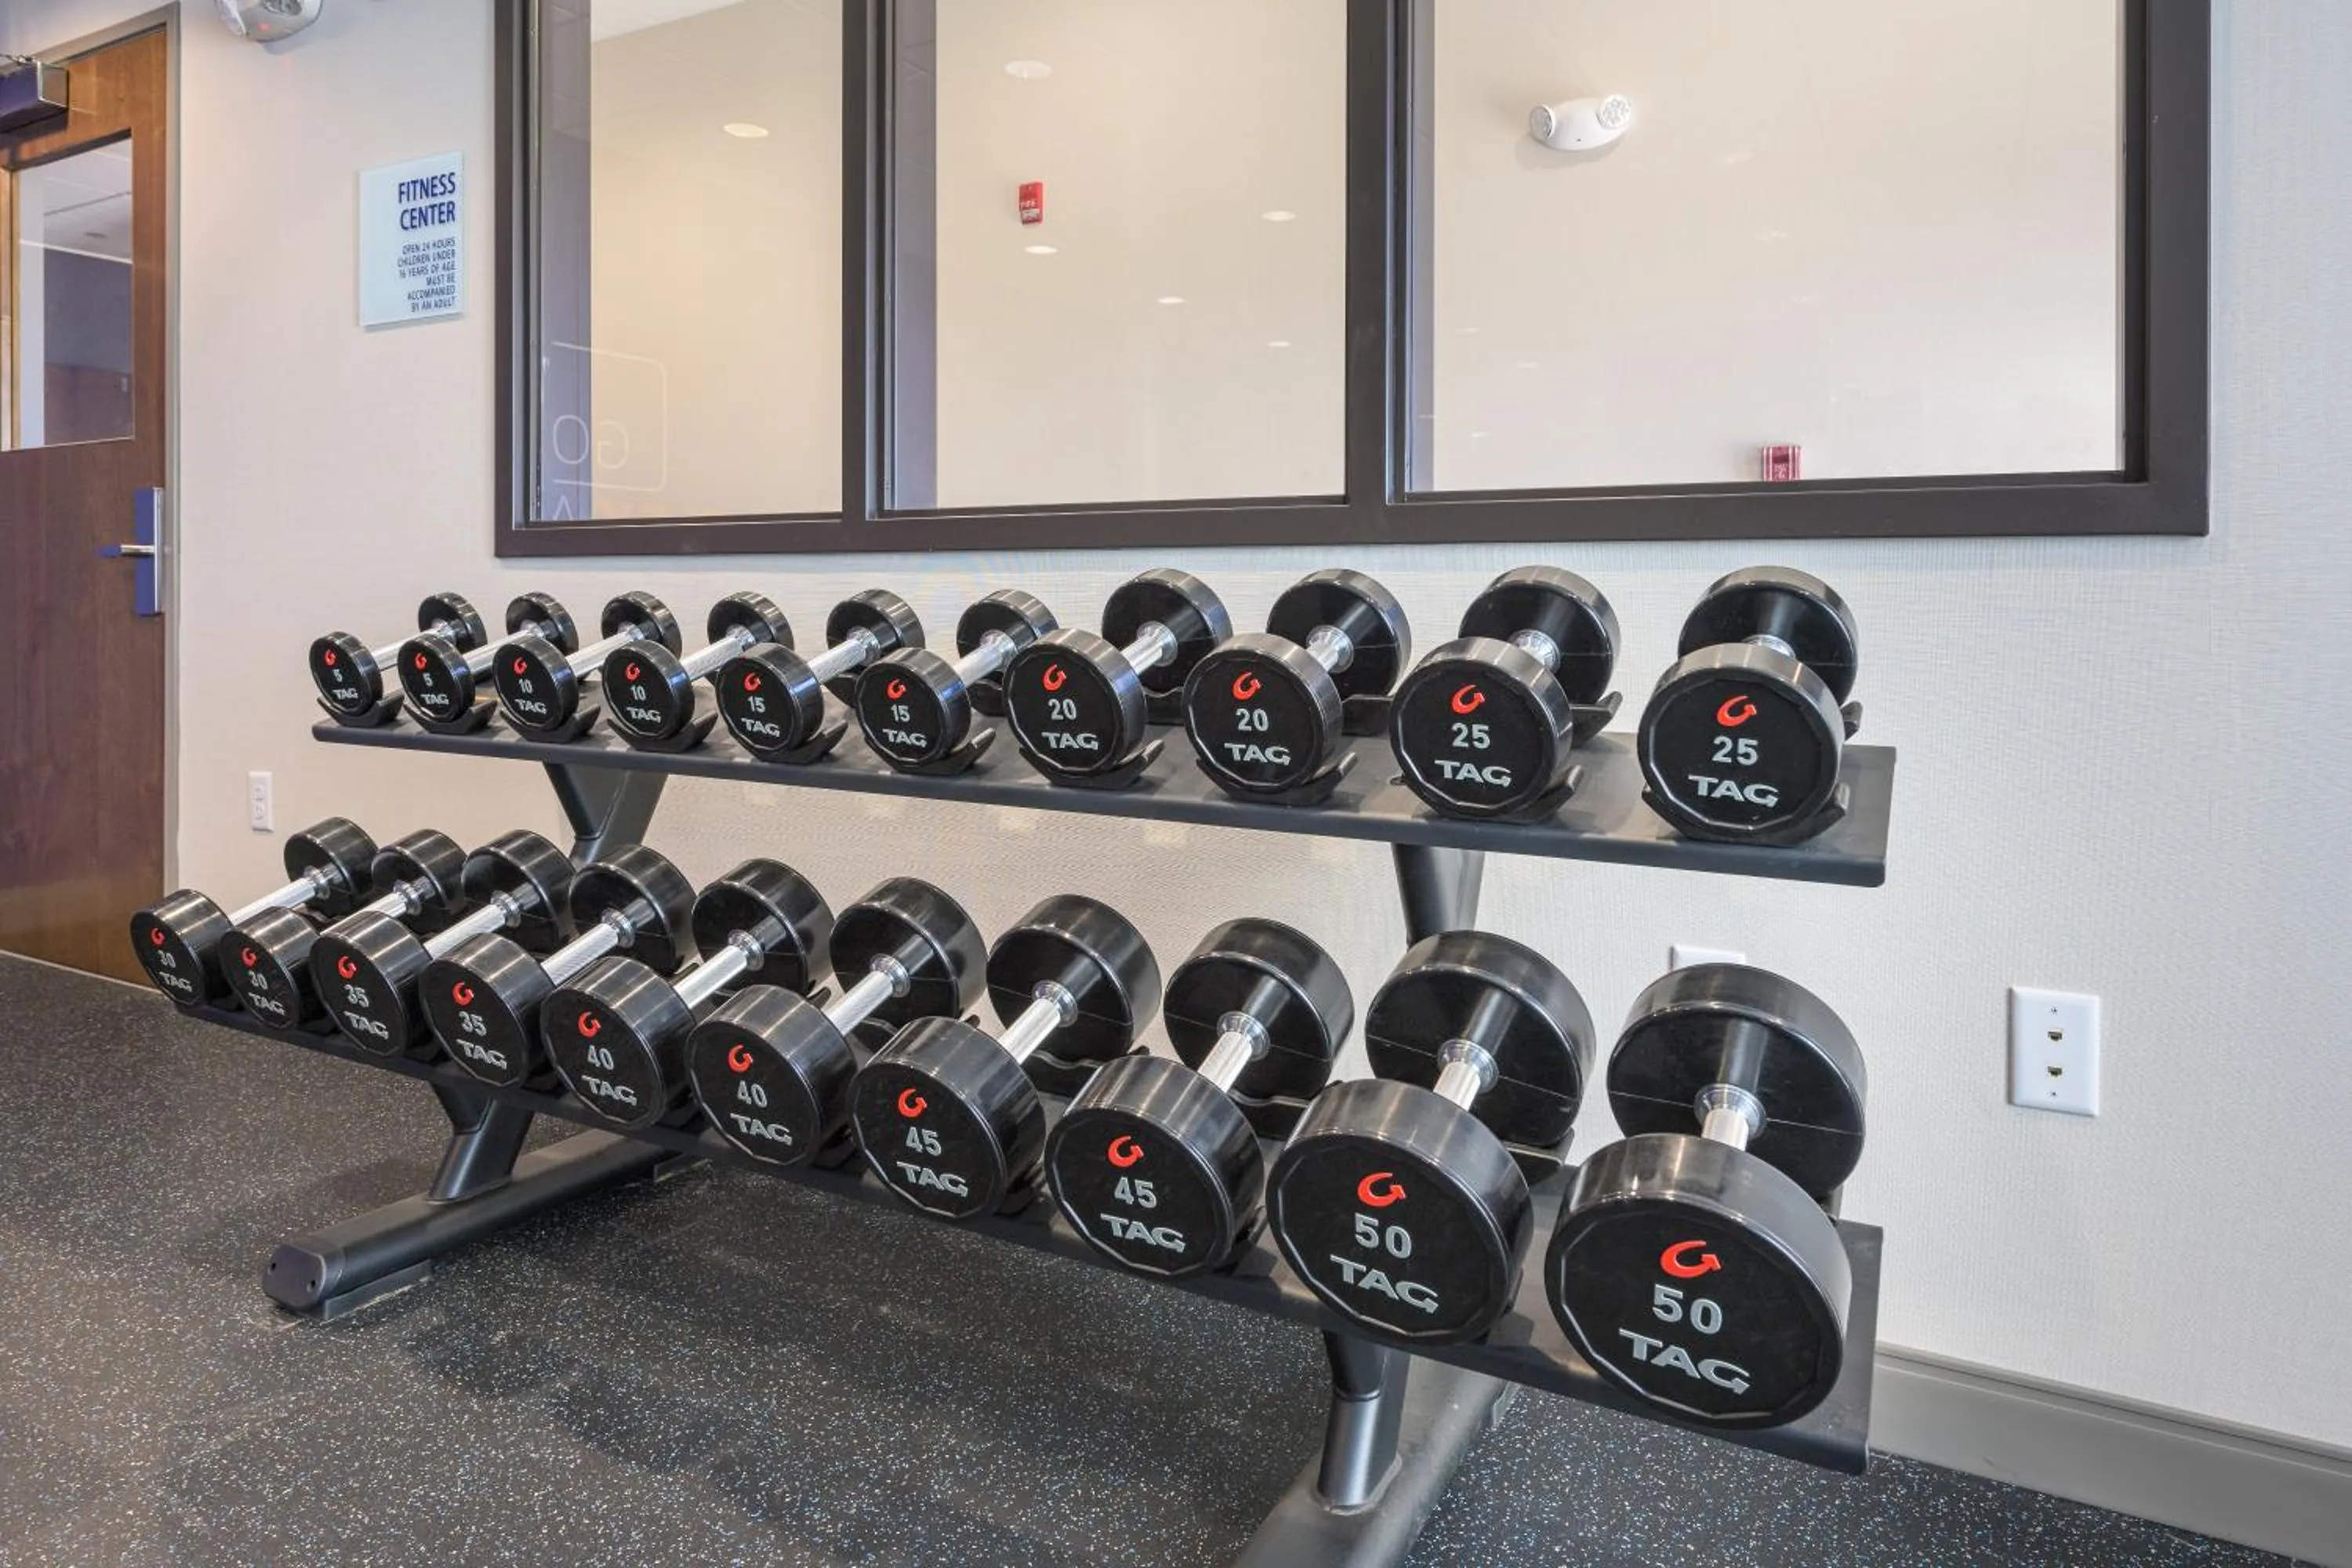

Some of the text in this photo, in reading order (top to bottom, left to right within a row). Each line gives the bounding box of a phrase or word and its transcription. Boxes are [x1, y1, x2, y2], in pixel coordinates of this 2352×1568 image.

[398, 172, 456, 204] FITNESS
[400, 200, 456, 230] CENTER
[402, 238, 456, 254] OPEN 24 HOURS
[397, 249, 456, 267] CHILDREN UNDER
[408, 265, 429, 277] YEARS
[431, 263, 439, 274] OF
[442, 260, 456, 271] AGE
[426, 272, 456, 286] MUST BE
[408, 285, 456, 300] ACCOMPANIED
[411, 296, 456, 312] BY AN ADULT
[332, 668, 343, 682] 5
[423, 673, 434, 687] 5
[518, 679, 533, 694] 10
[332, 688, 359, 700] TAG
[421, 693, 450, 705] TAG
[630, 684, 647, 701] 10
[747, 695, 766, 713] 15
[514, 699, 547, 715] TAG
[626, 706, 662, 724] TAG
[890, 703, 910, 723] 15
[1047, 698, 1077, 720] 20
[740, 717, 781, 738] TAG
[1236, 708, 1269, 732] 20
[882, 728, 927, 748] TAG
[1040, 731, 1099, 750] TAG
[1451, 722, 1490, 750] 25
[1224, 742, 1291, 766] TAG
[1711, 736, 1759, 766] 25
[1434, 759, 1512, 788] TAG
[1687, 774, 1779, 808] TAG
[158, 949, 176, 968] 30
[159, 972, 192, 993] TAG
[249, 970, 268, 990] 30
[248, 993, 285, 1015] TAG
[343, 983, 369, 1007] 35
[343, 1011, 389, 1040] TAG
[459, 1011, 487, 1036] 35
[455, 1038, 508, 1071] TAG
[587, 1044, 615, 1070] 40
[580, 1074, 637, 1107] TAG
[737, 1080, 768, 1108] 40
[729, 1112, 793, 1147] TAG
[906, 1126, 942, 1156] 45
[895, 1160, 969, 1198] TAG
[1114, 1175, 1157, 1209] 45
[1099, 1213, 1186, 1254] TAG
[1354, 1212, 1412, 1259] 50
[1330, 1254, 1439, 1316] TAG
[1652, 1283, 1722, 1334] 50
[1617, 1327, 1751, 1396] TAG
